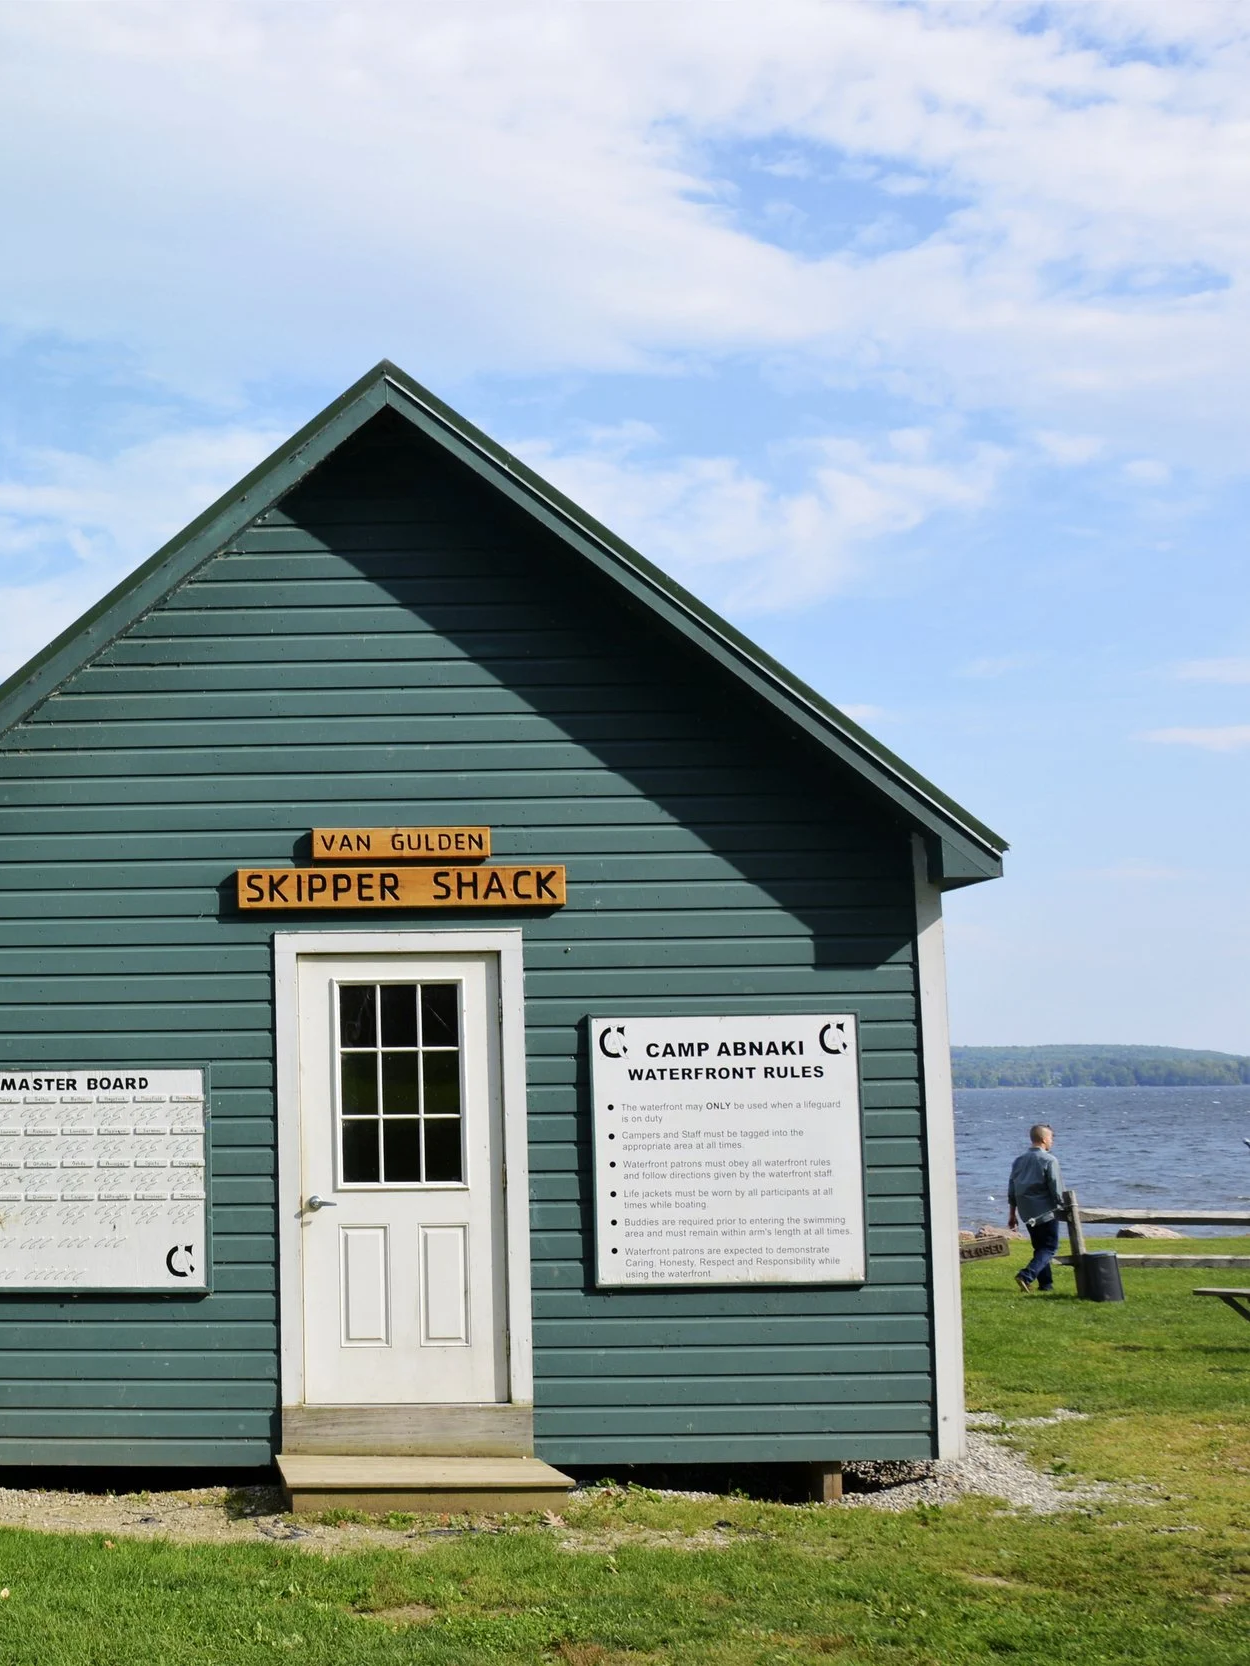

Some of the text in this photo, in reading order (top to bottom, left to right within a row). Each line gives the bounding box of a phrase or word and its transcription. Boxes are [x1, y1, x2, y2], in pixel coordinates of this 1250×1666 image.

[320, 833, 484, 852] VAN GULDEN
[245, 870, 557, 902] SKIPPER SHACK
[646, 1041, 804, 1057] CAMP ABNAKI
[628, 1066, 824, 1080] WATERFRONT RULES
[0, 1077, 149, 1091] MASTER BOARD
[621, 1103, 637, 1111] The
[639, 1102, 683, 1111] waterfront
[685, 1104, 704, 1112] may
[706, 1102, 731, 1110] ONLY
[747, 1101, 768, 1109] used
[770, 1101, 793, 1109] when
[804, 1100, 841, 1110] lifeguard
[622, 1131, 661, 1141] Campers
[663, 1130, 680, 1138] and
[682, 1130, 702, 1138] Staff
[703, 1130, 725, 1138] must
[740, 1129, 770, 1139] tagged
[772, 1129, 788, 1137] into
[622, 1142, 671, 1152] appropriate
[706, 1141, 716, 1149] all
[622, 1158, 831, 1169] Waterfront patrons must obey all waterfront rules
[623, 1171, 640, 1179] and
[642, 1171, 668, 1179] follow
[713, 1170, 737, 1180] given
[739, 1170, 750, 1180] by
[752, 1170, 766, 1178] the
[768, 1170, 812, 1178] waterfront
[642, 1189, 673, 1199] jackets
[675, 1189, 696, 1197] must
[698, 1189, 709, 1197] be
[735, 1188, 746, 1198] by
[748, 1188, 758, 1196] all
[760, 1188, 810, 1198] participants
[624, 1201, 648, 1209] times
[624, 1218, 659, 1226] Buddies
[679, 1218, 713, 1227] required
[717, 1218, 735, 1227] prior
[739, 1217, 747, 1225] to
[750, 1217, 784, 1227] entering
[803, 1216, 845, 1226] swimming
[647, 1229, 662, 1237] and
[665, 1229, 686, 1237] must
[721, 1228, 746, 1236] within
[749, 1228, 771, 1236] arm's
[775, 1228, 800, 1237] length
[804, 1227, 812, 1235] at
[815, 1227, 824, 1235] all
[625, 1247, 671, 1255] Waterfront
[672, 1247, 705, 1257] patrons
[724, 1246, 763, 1256] expected
[765, 1246, 774, 1254] to
[776, 1246, 830, 1254] demonstrate
[960, 1244, 1003, 1259] CLOSED
[699, 1258, 735, 1268] Respect
[756, 1257, 816, 1267] Responsibility
[817, 1257, 840, 1265] while
[625, 1269, 649, 1279] using
[651, 1269, 665, 1277] the
